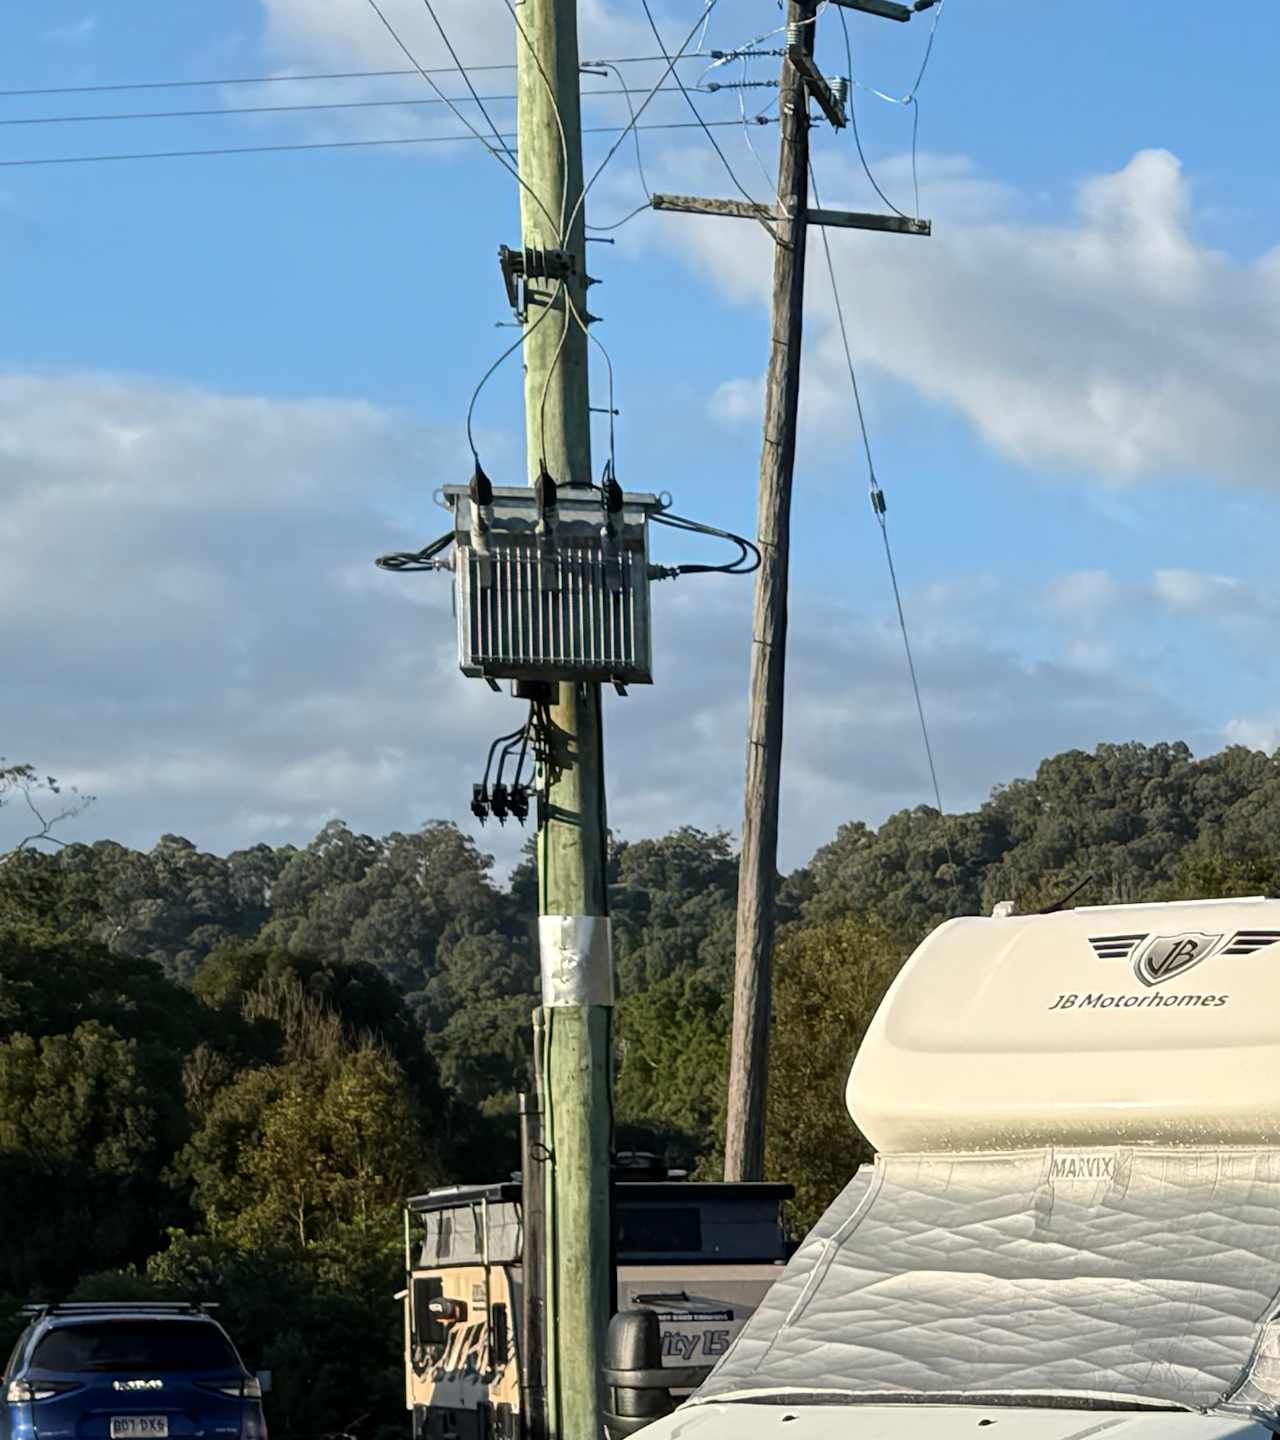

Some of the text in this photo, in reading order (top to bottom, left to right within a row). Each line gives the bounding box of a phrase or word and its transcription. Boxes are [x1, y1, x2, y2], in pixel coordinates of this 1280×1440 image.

[1147, 938, 1198, 976] JB
[1049, 992, 1229, 1010] JB Motorhomes
[1053, 1157, 1113, 1177] MARVIX
[662, 1330, 730, 1360] ity 15
